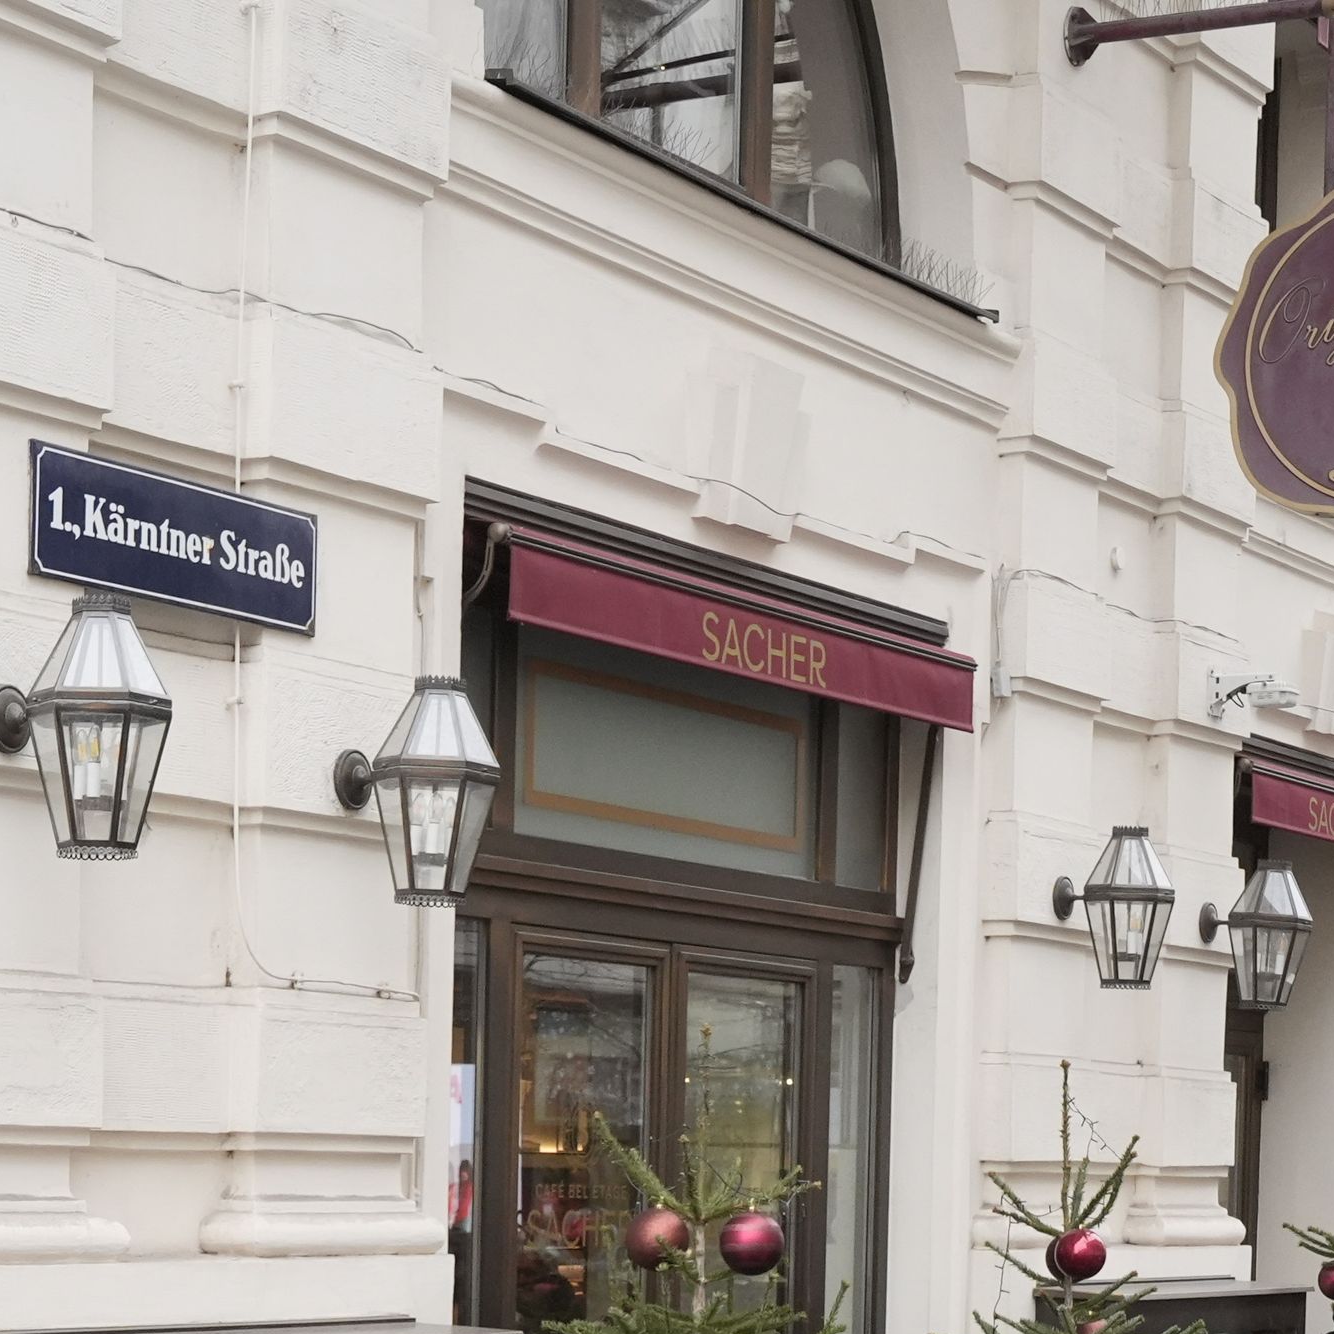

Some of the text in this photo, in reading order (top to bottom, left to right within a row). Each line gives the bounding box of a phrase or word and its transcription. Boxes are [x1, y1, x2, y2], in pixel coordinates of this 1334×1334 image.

[83, 493, 215, 566] Kärntner
[219, 529, 306, 589] Straße
[701, 611, 827, 689] SACHER
